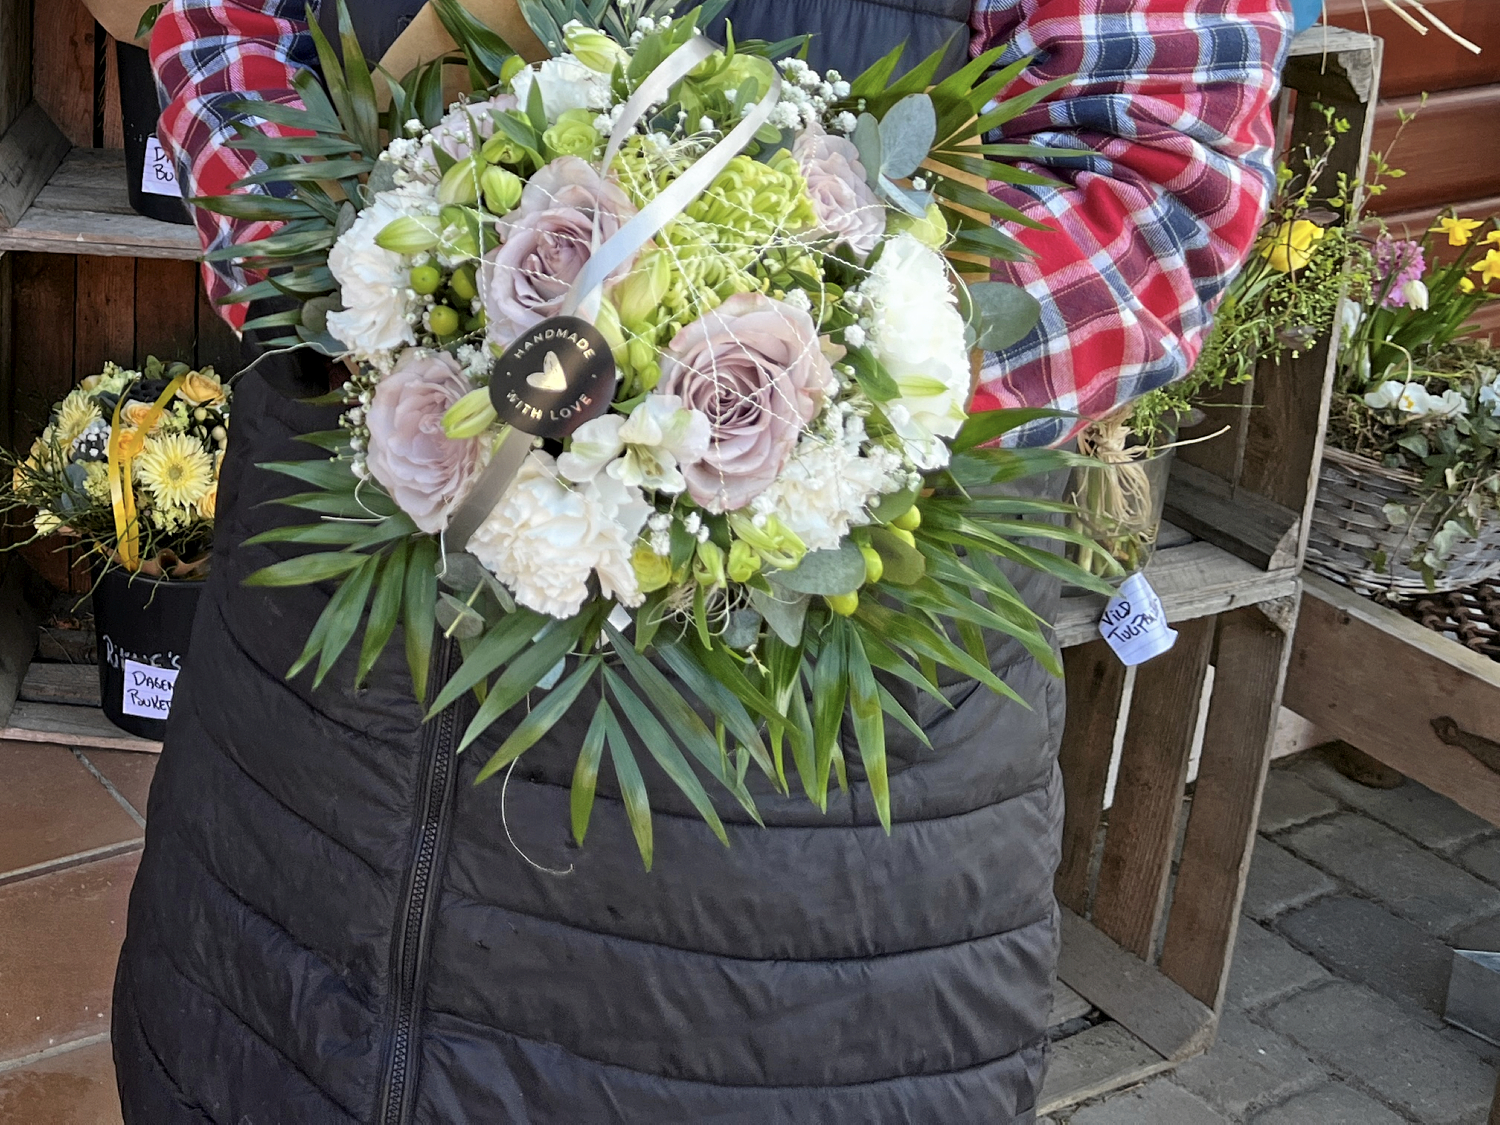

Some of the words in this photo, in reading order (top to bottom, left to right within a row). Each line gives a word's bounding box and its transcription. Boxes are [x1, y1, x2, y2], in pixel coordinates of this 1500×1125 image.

[513, 328, 596, 359] HANDMADE
[506, 389, 543, 421] WITH
[550, 393, 592, 421] LOVE
